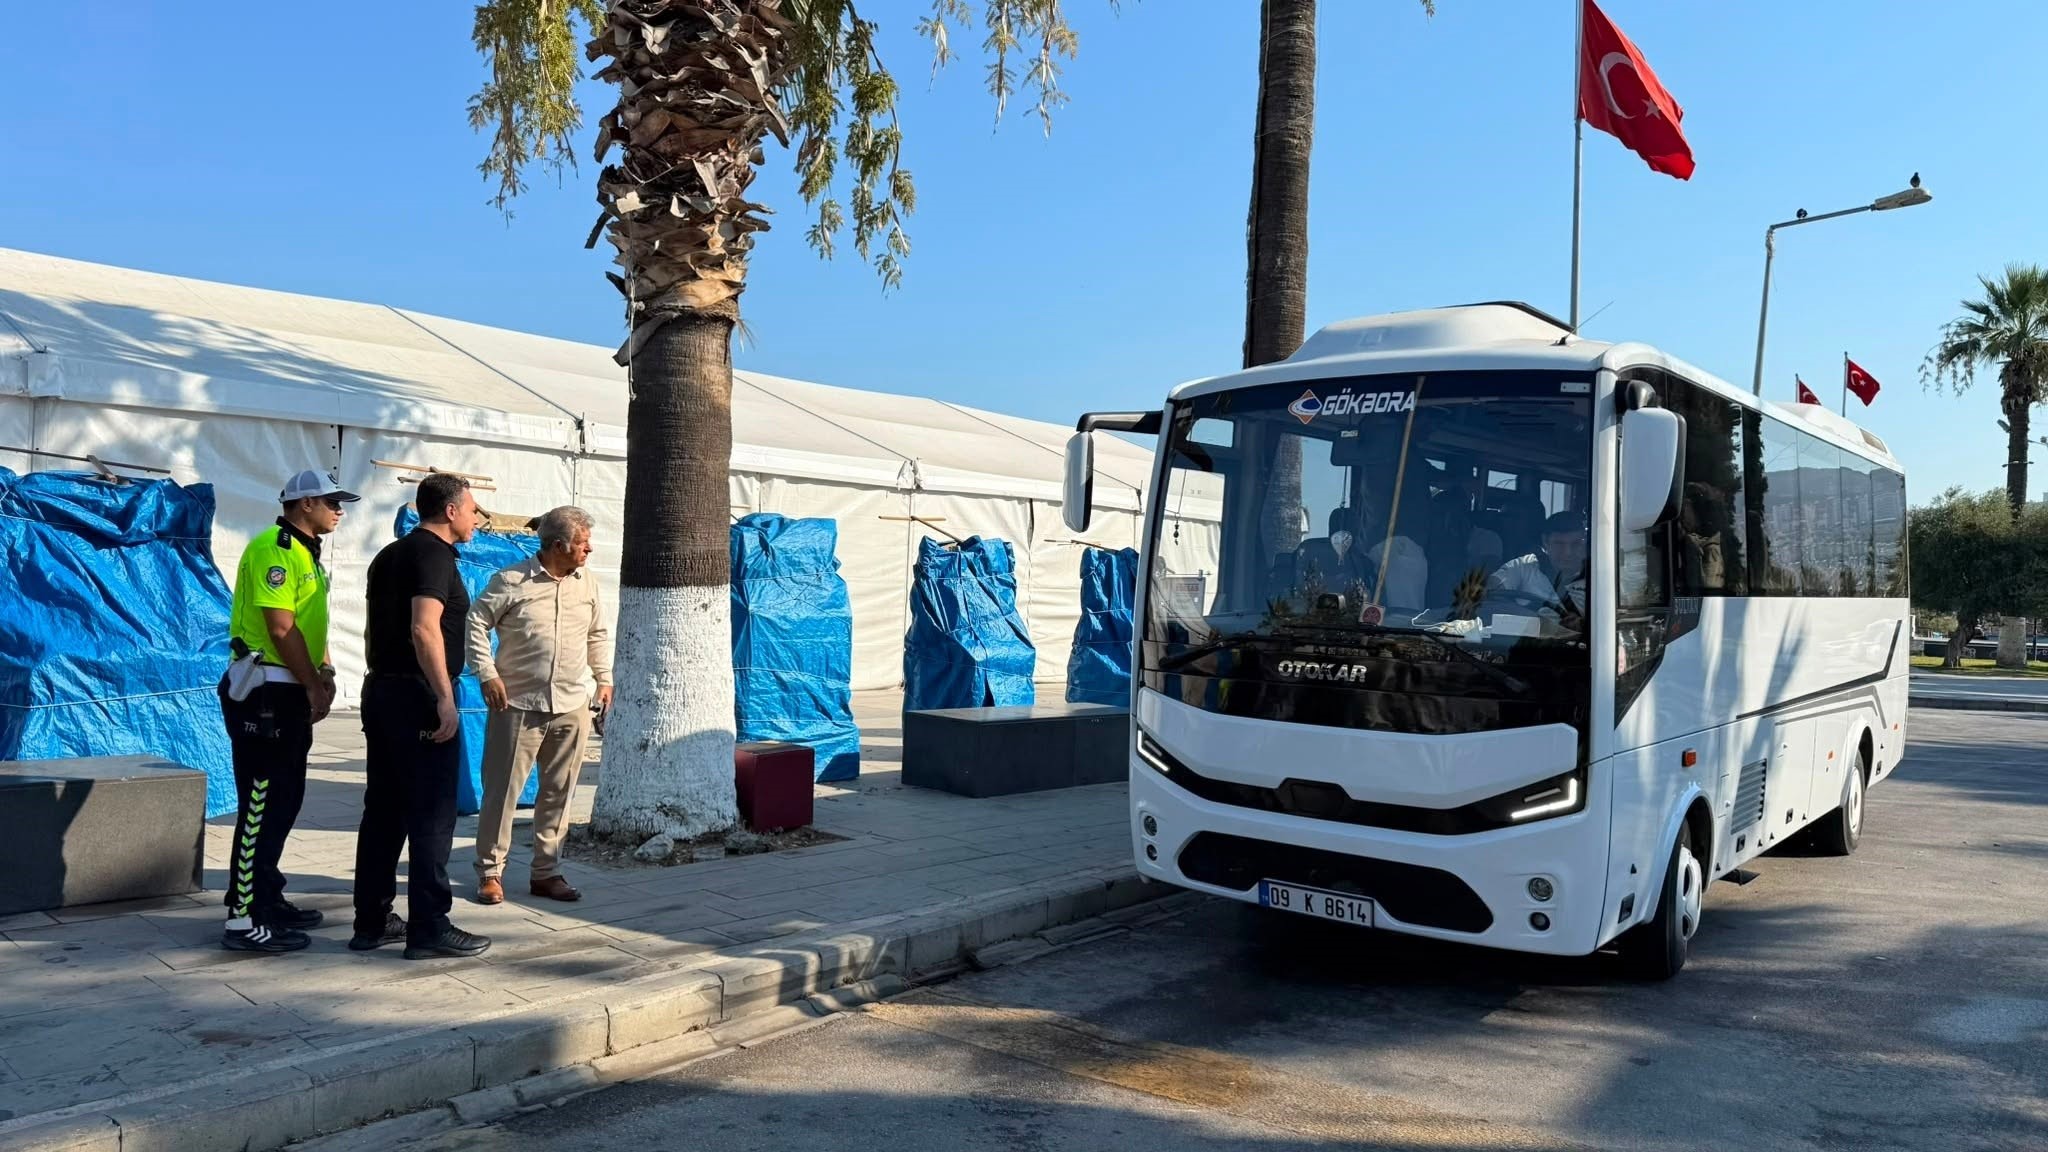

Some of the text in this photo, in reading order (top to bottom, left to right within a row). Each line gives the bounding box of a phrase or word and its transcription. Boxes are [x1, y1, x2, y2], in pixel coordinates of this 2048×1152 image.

[1321, 388, 1416, 416] GÖKBORA
[1277, 660, 1367, 682] OTOKAR
[1270, 887, 1366, 922] 09 K 8614
